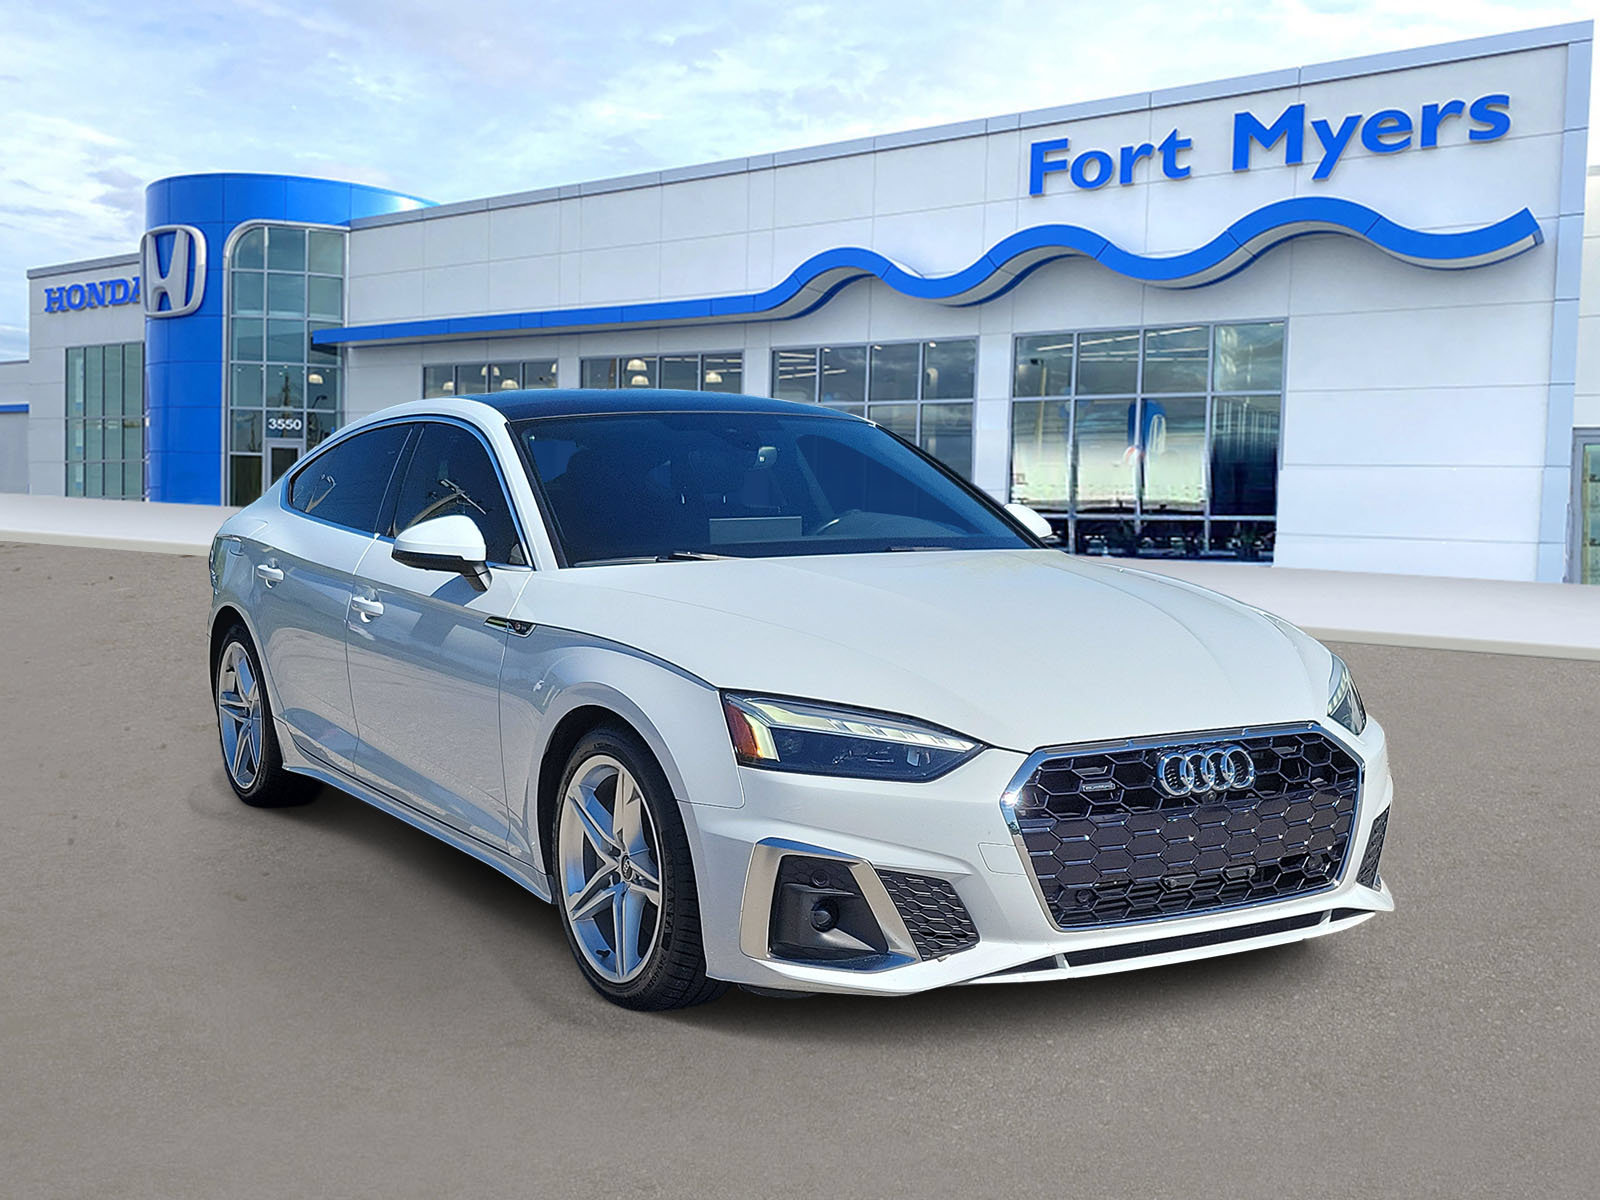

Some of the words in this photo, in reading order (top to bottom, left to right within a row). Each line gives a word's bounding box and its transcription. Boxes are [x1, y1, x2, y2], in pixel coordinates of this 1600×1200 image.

[1029, 127, 1193, 198] Fort
[1232, 93, 1512, 182] Myers
[268, 418, 302, 430] 3550
